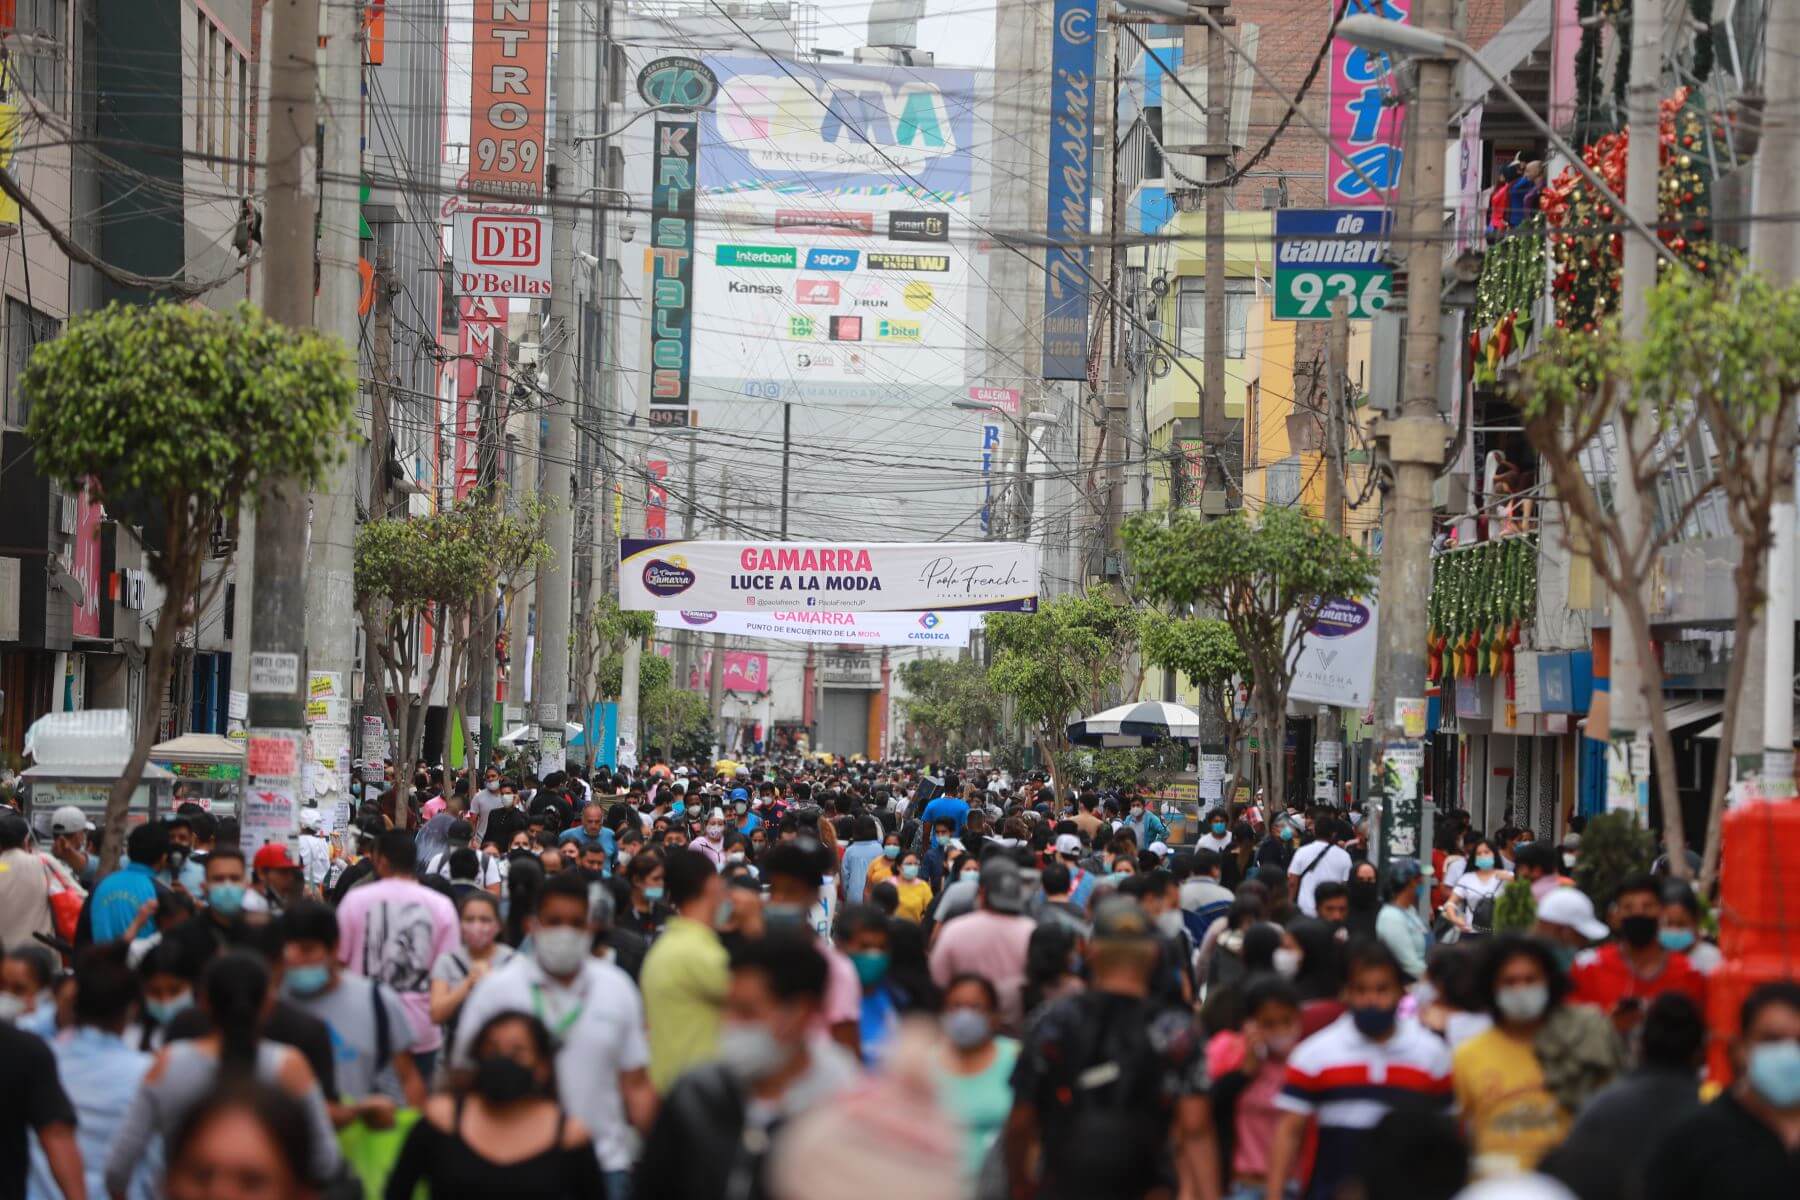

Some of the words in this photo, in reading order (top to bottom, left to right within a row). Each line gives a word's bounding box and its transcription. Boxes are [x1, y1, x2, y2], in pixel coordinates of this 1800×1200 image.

[477, 138, 538, 173] 959
[809, 152, 829, 163] DE
[894, 219, 925, 230] smart
[1336, 214, 1364, 234] de
[481, 227, 532, 257] D'B
[820, 255, 843, 266] BCP
[462, 273, 551, 294] D'Bellas
[729, 281, 783, 295] Kansas
[1290, 273, 1391, 316] 936
[977, 389, 1011, 401] GALERIA
[740, 547, 873, 572] GAMARRA
[731, 574, 774, 590] LUCE
[780, 575, 792, 590] A
[799, 575, 819, 591] LA
[825, 575, 882, 591] MODA
[961, 560, 1018, 593] French
[774, 611, 856, 625] GAMARRA
[746, 622, 773, 632] PUNTO
[774, 624, 785, 633] DE
[786, 626, 833, 637] ENCUENTRO
[833, 629, 845, 637] DE
